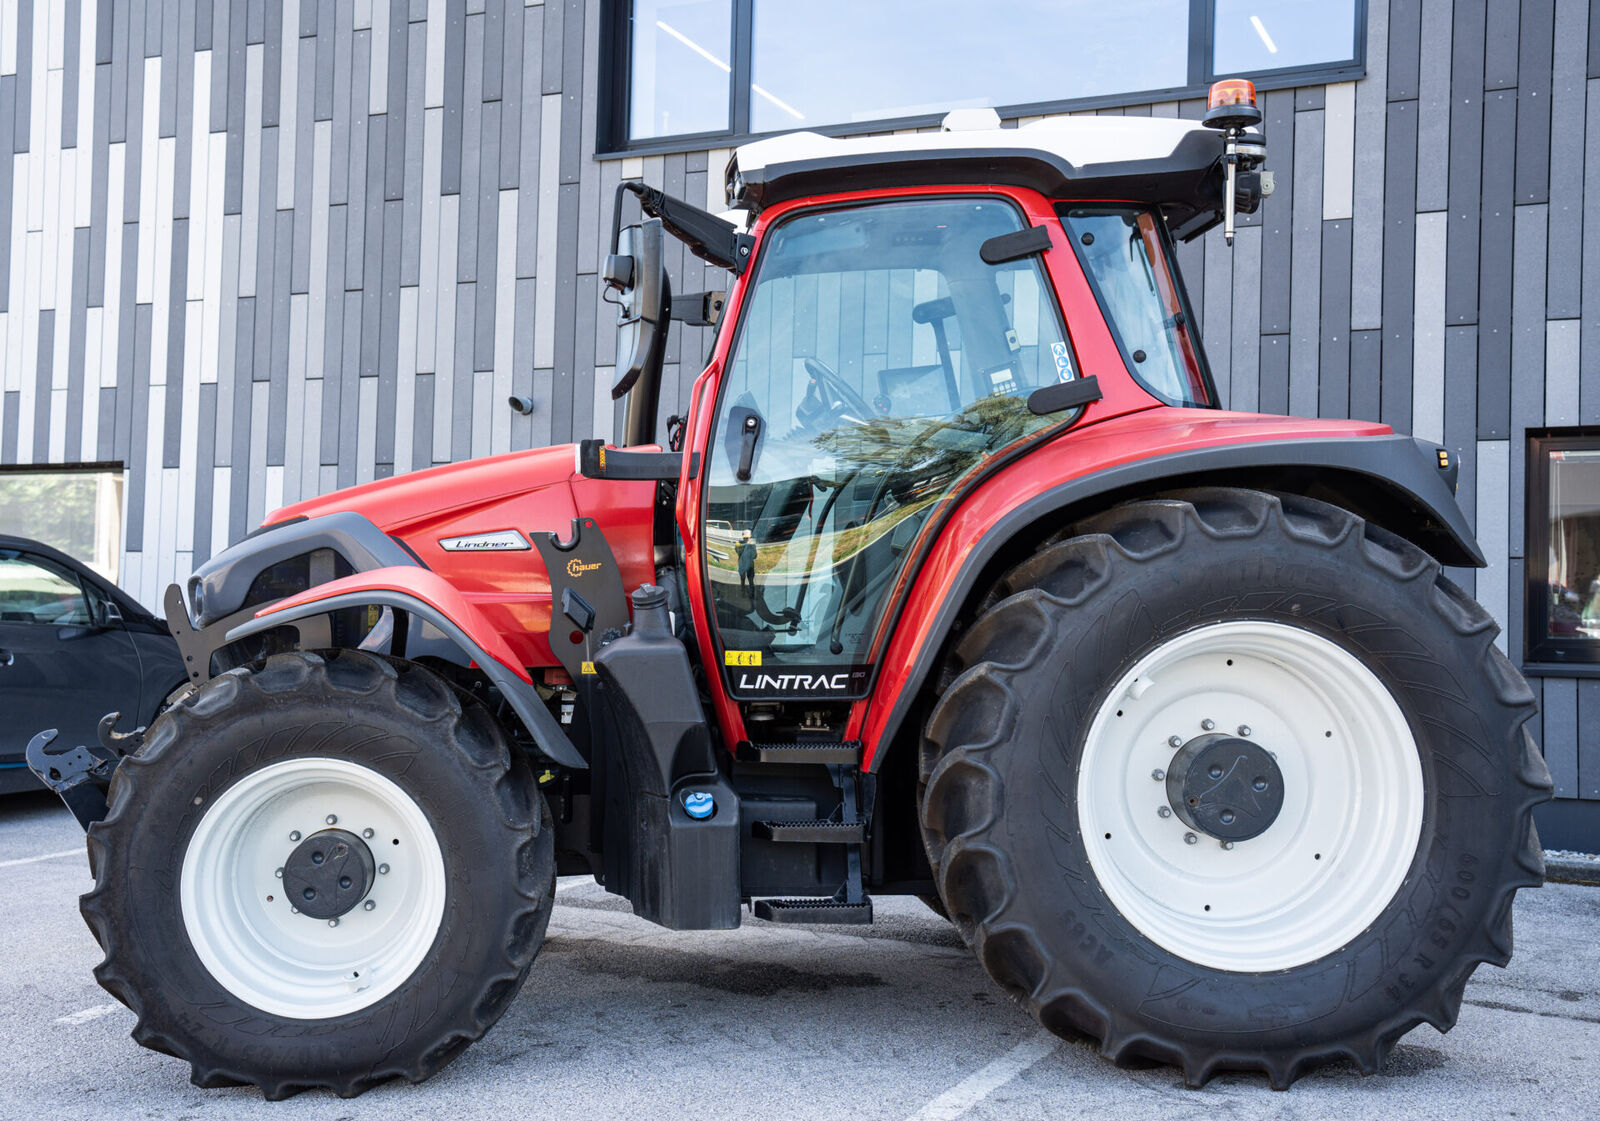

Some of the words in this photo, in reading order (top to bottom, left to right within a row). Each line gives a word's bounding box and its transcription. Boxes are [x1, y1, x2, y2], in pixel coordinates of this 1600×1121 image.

[455, 540, 515, 550] Lindner
[571, 560, 603, 573] hauer
[739, 673, 850, 691] LINTRAC
